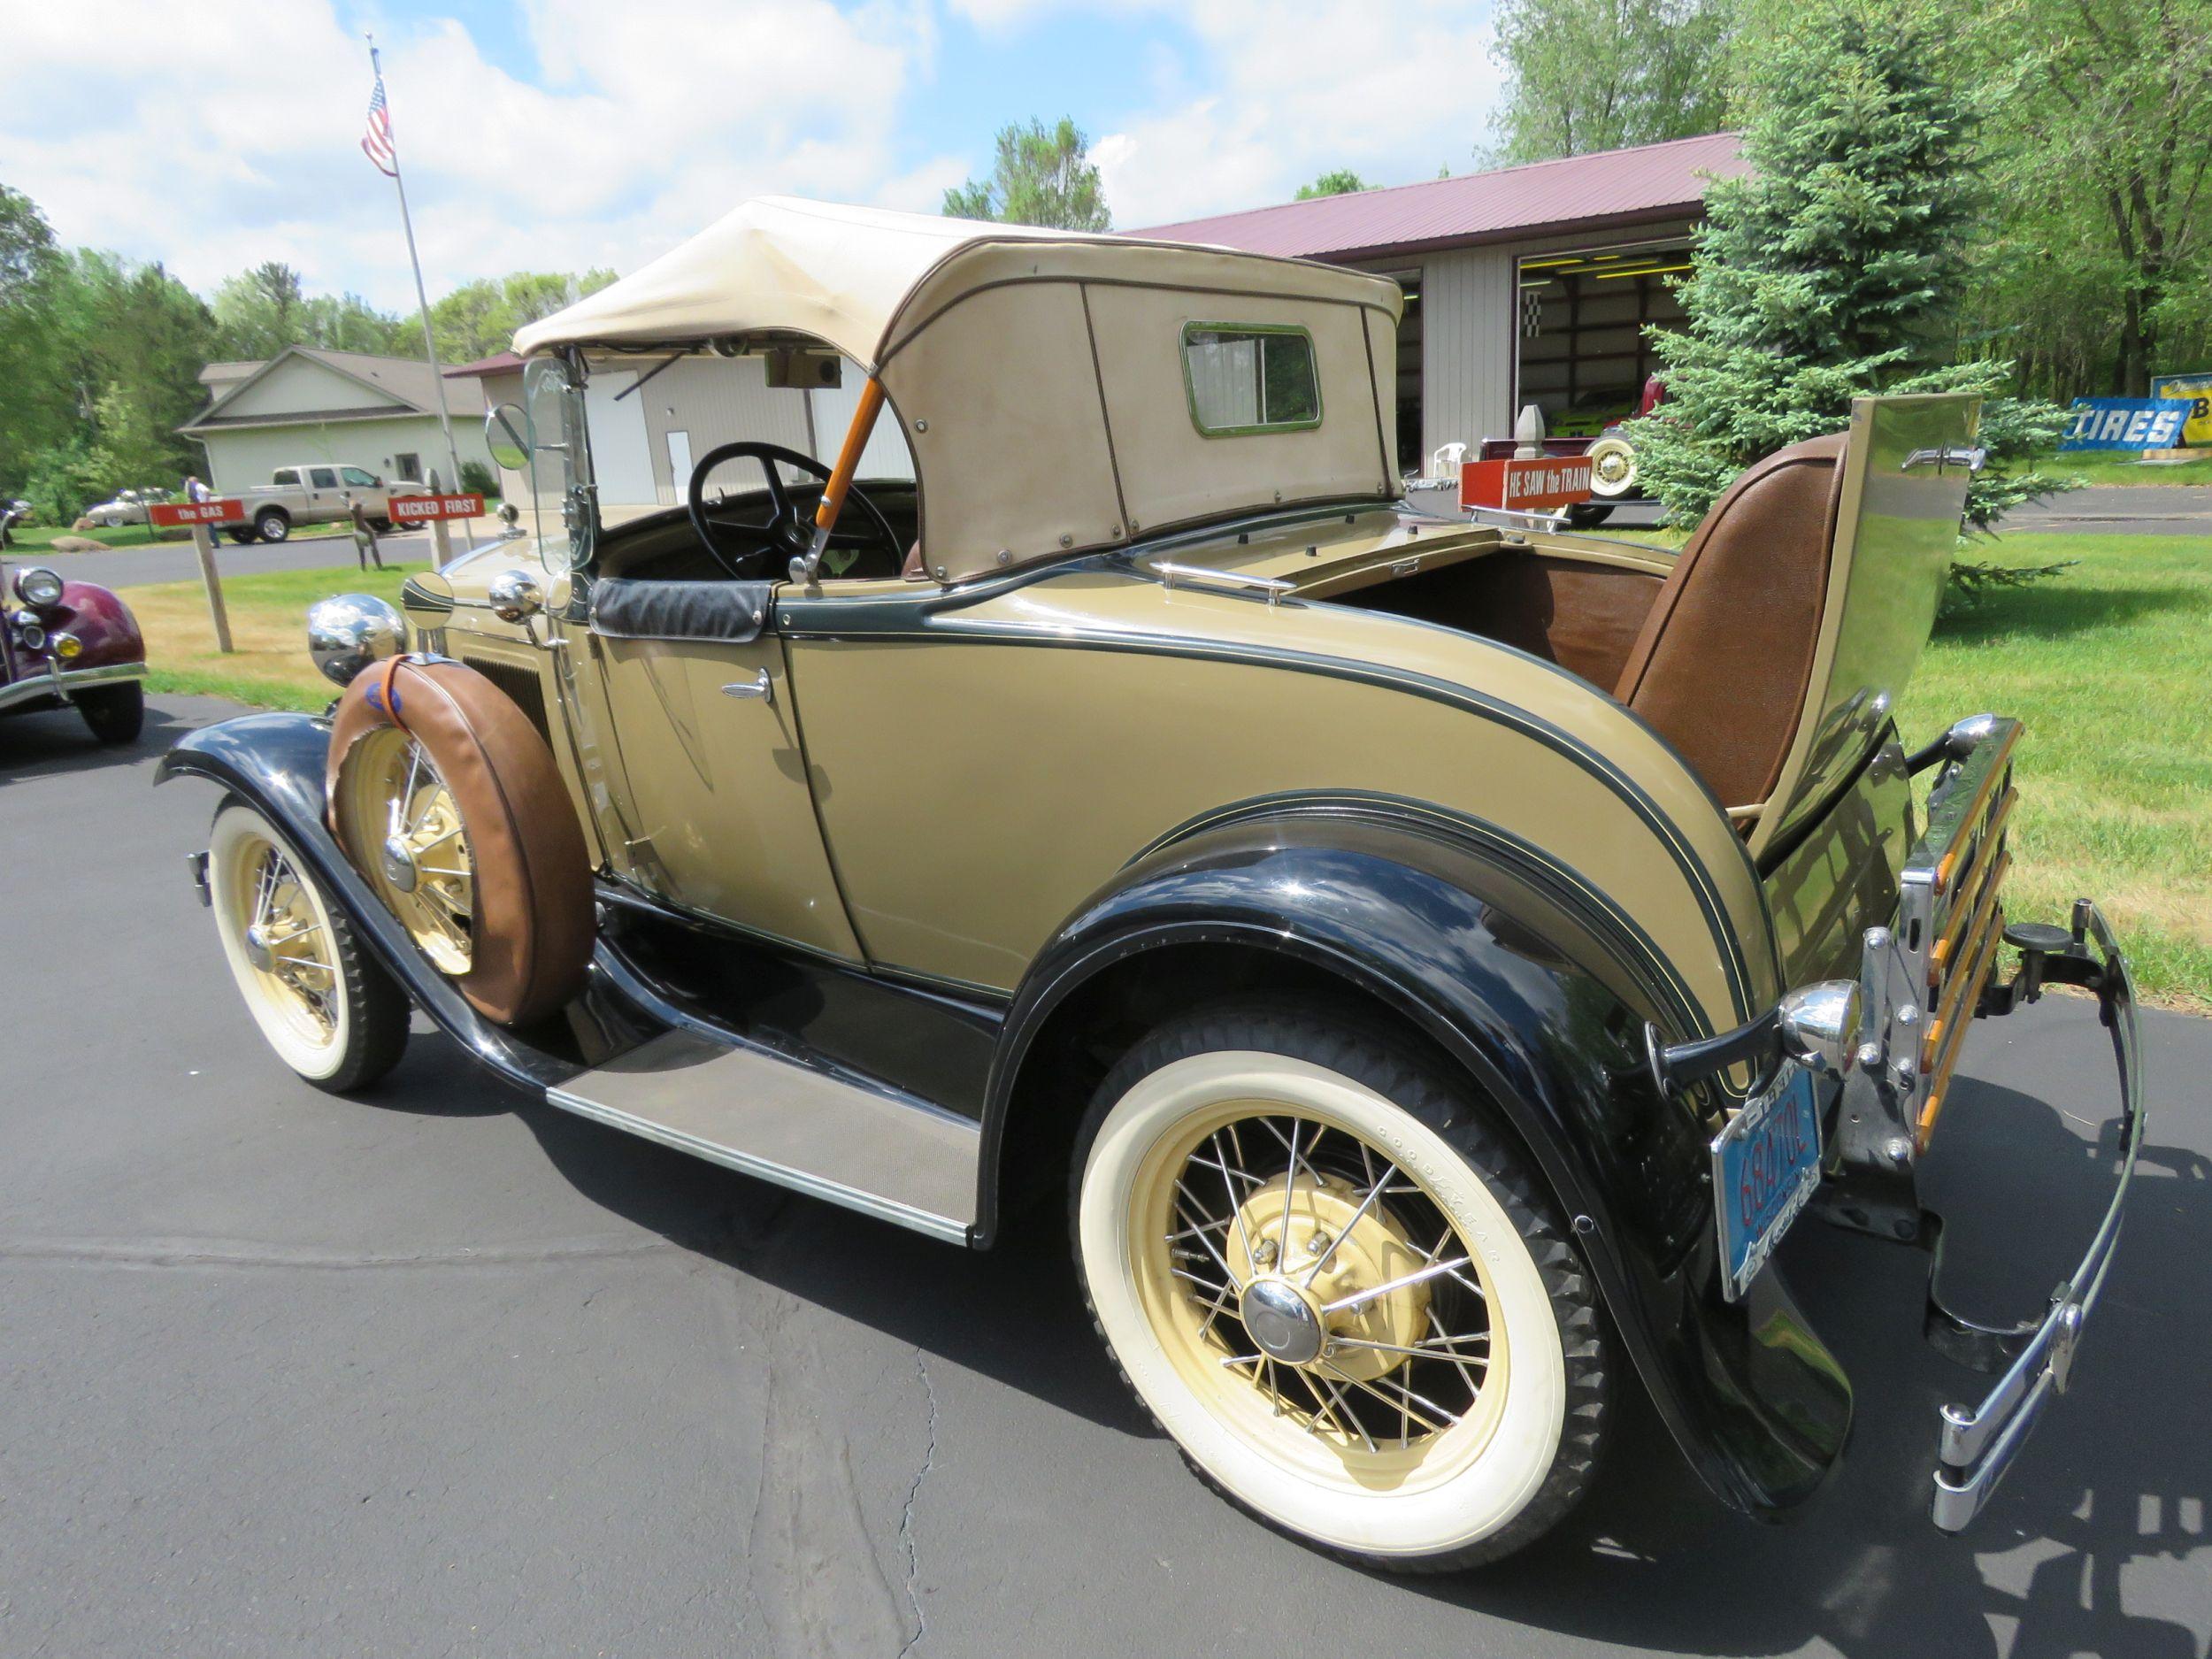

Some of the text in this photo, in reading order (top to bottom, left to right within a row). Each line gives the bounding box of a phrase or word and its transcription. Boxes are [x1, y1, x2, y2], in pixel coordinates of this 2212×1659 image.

[2073, 410, 2180, 442] TIRES
[1510, 467, 1590, 497] HE SAW the TRAIN
[177, 505, 224, 520] the GAS
[398, 497, 477, 518] KICKED FIRST
